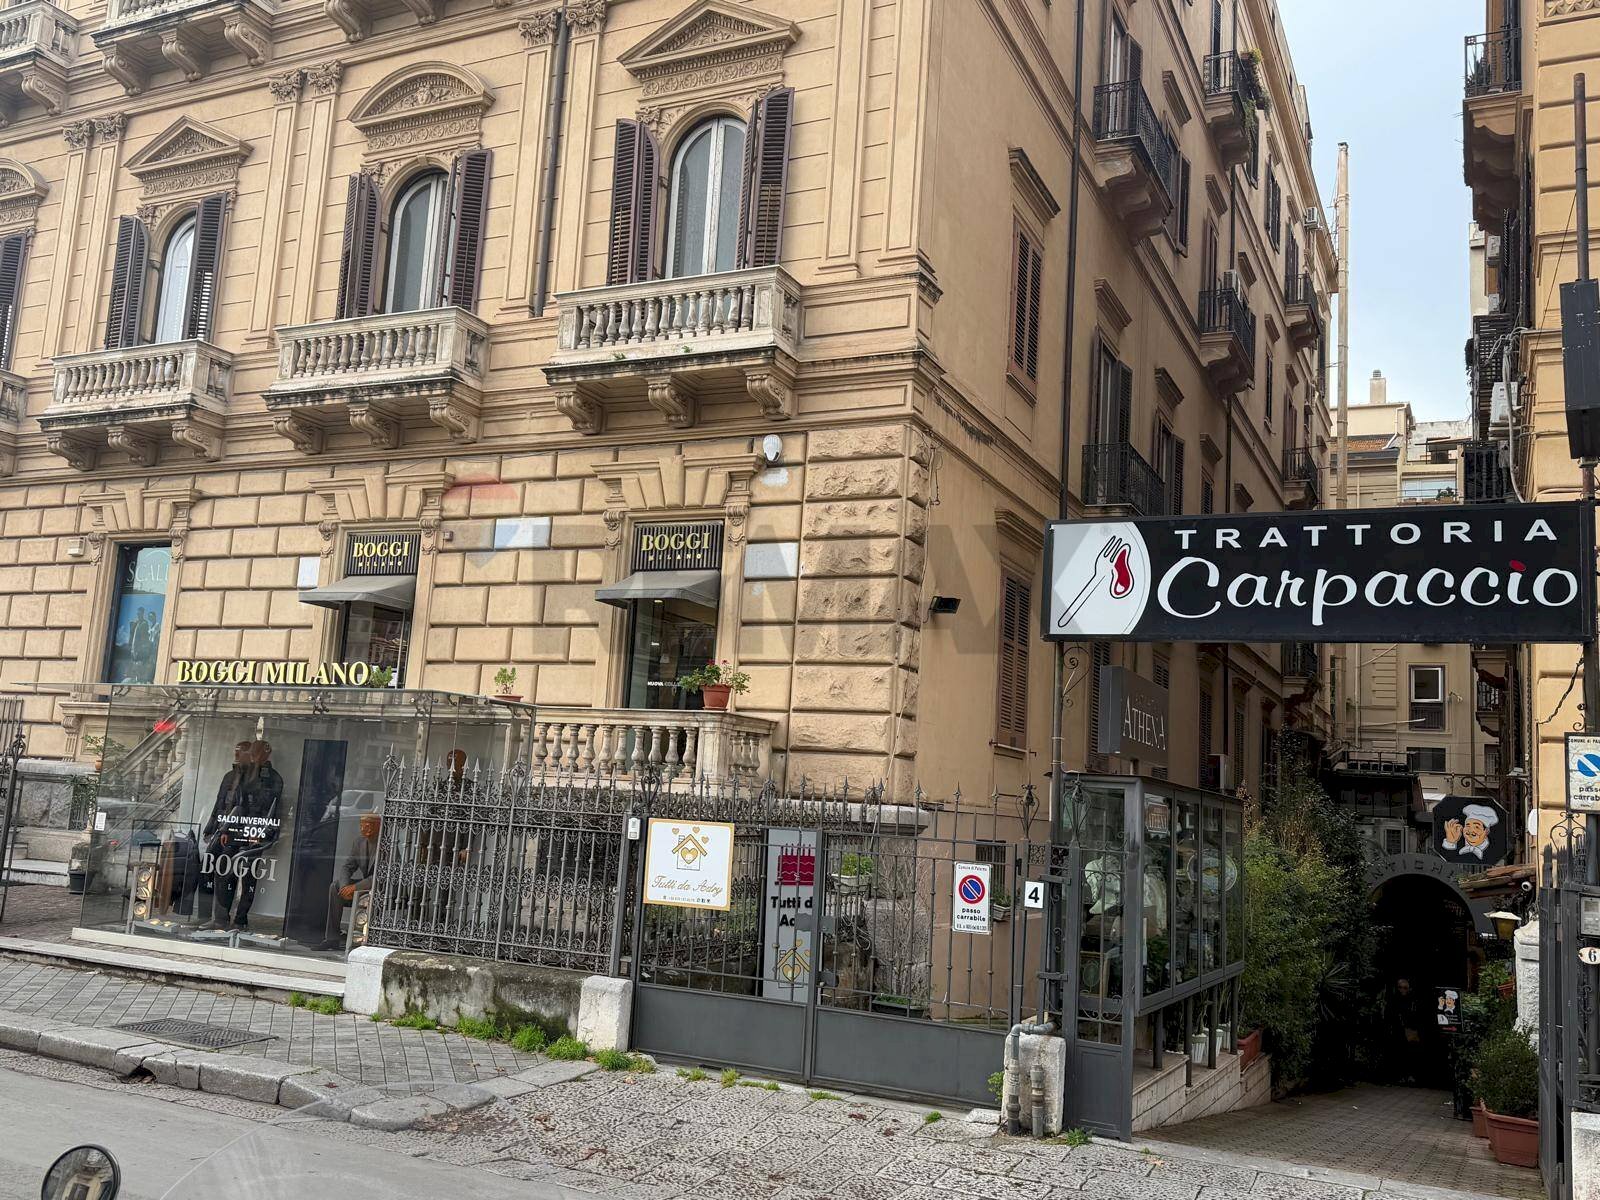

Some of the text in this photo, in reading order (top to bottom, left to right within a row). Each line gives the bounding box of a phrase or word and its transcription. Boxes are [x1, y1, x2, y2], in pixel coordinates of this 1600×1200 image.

[641, 533, 711, 551] BOGGI
[1174, 518, 1558, 550] TRATTORIA
[352, 541, 410, 558] BOGGI
[648, 554, 703, 562] MILANO
[1157, 556, 1579, 627] Carpaccio
[176, 660, 369, 686] BOGGI MILANO
[1122, 695, 1166, 751] ATHENA
[217, 814, 281, 827] SALDI INVERNALI
[200, 852, 280, 882] BOGGI
[652, 875, 677, 889] Tutti
[677, 879, 691, 890] da
[771, 896, 813, 909] Tutti d
[1028, 886, 1040, 904] 4
[956, 913, 986, 922] carrabile
[1588, 948, 1597, 963] 6
